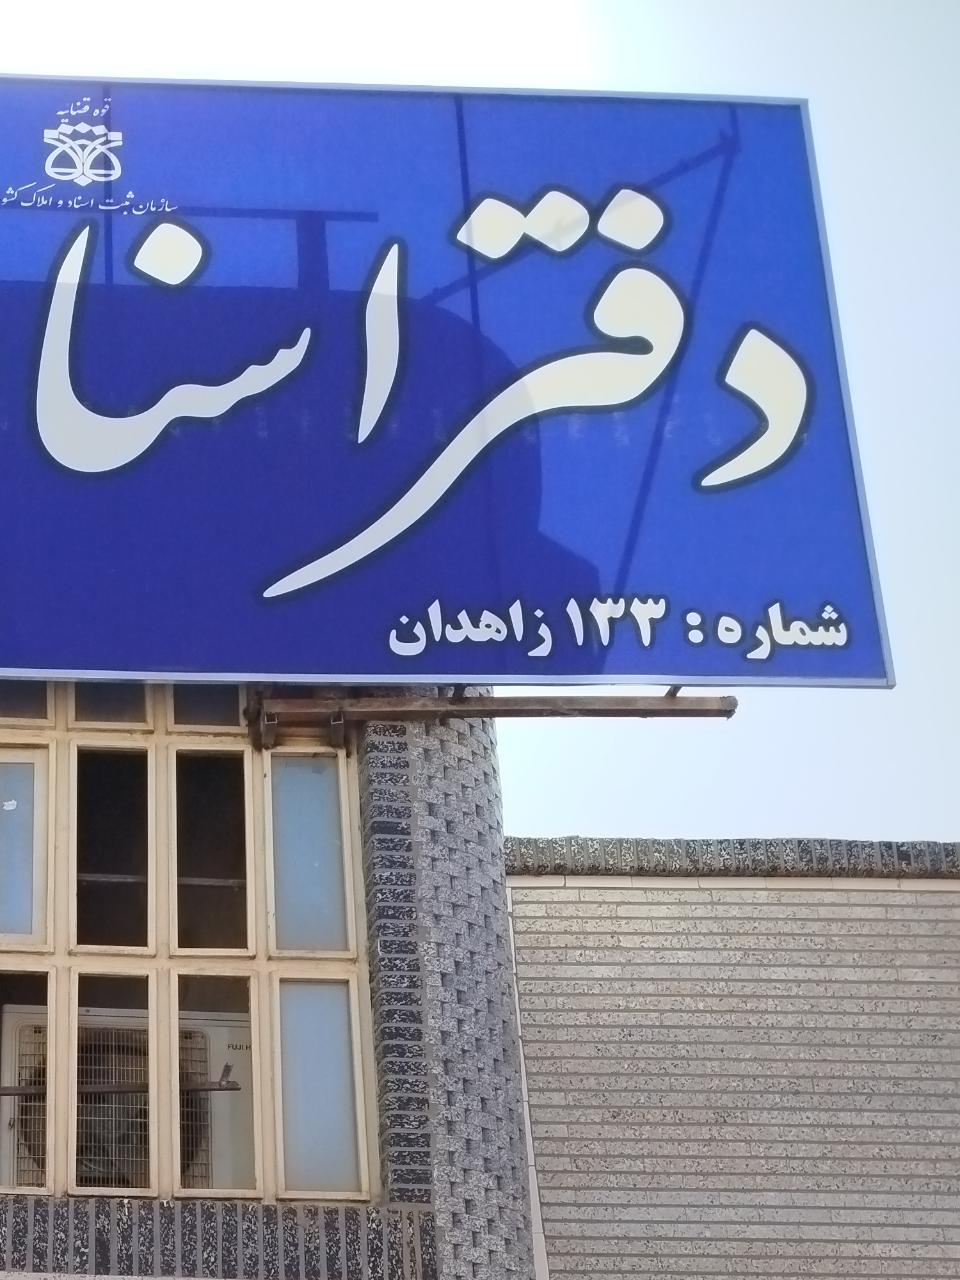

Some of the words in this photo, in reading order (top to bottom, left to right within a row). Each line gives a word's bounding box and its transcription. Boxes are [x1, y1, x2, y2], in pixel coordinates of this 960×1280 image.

[67, 195, 94, 209] اسناد
[98, 190, 135, 215] ثبت
[132, 198, 178, 215] سازمان
[262, 188, 808, 600] دفتر
[388, 599, 554, 657] زاهدان
[565, 597, 666, 647] ۱۳۳
